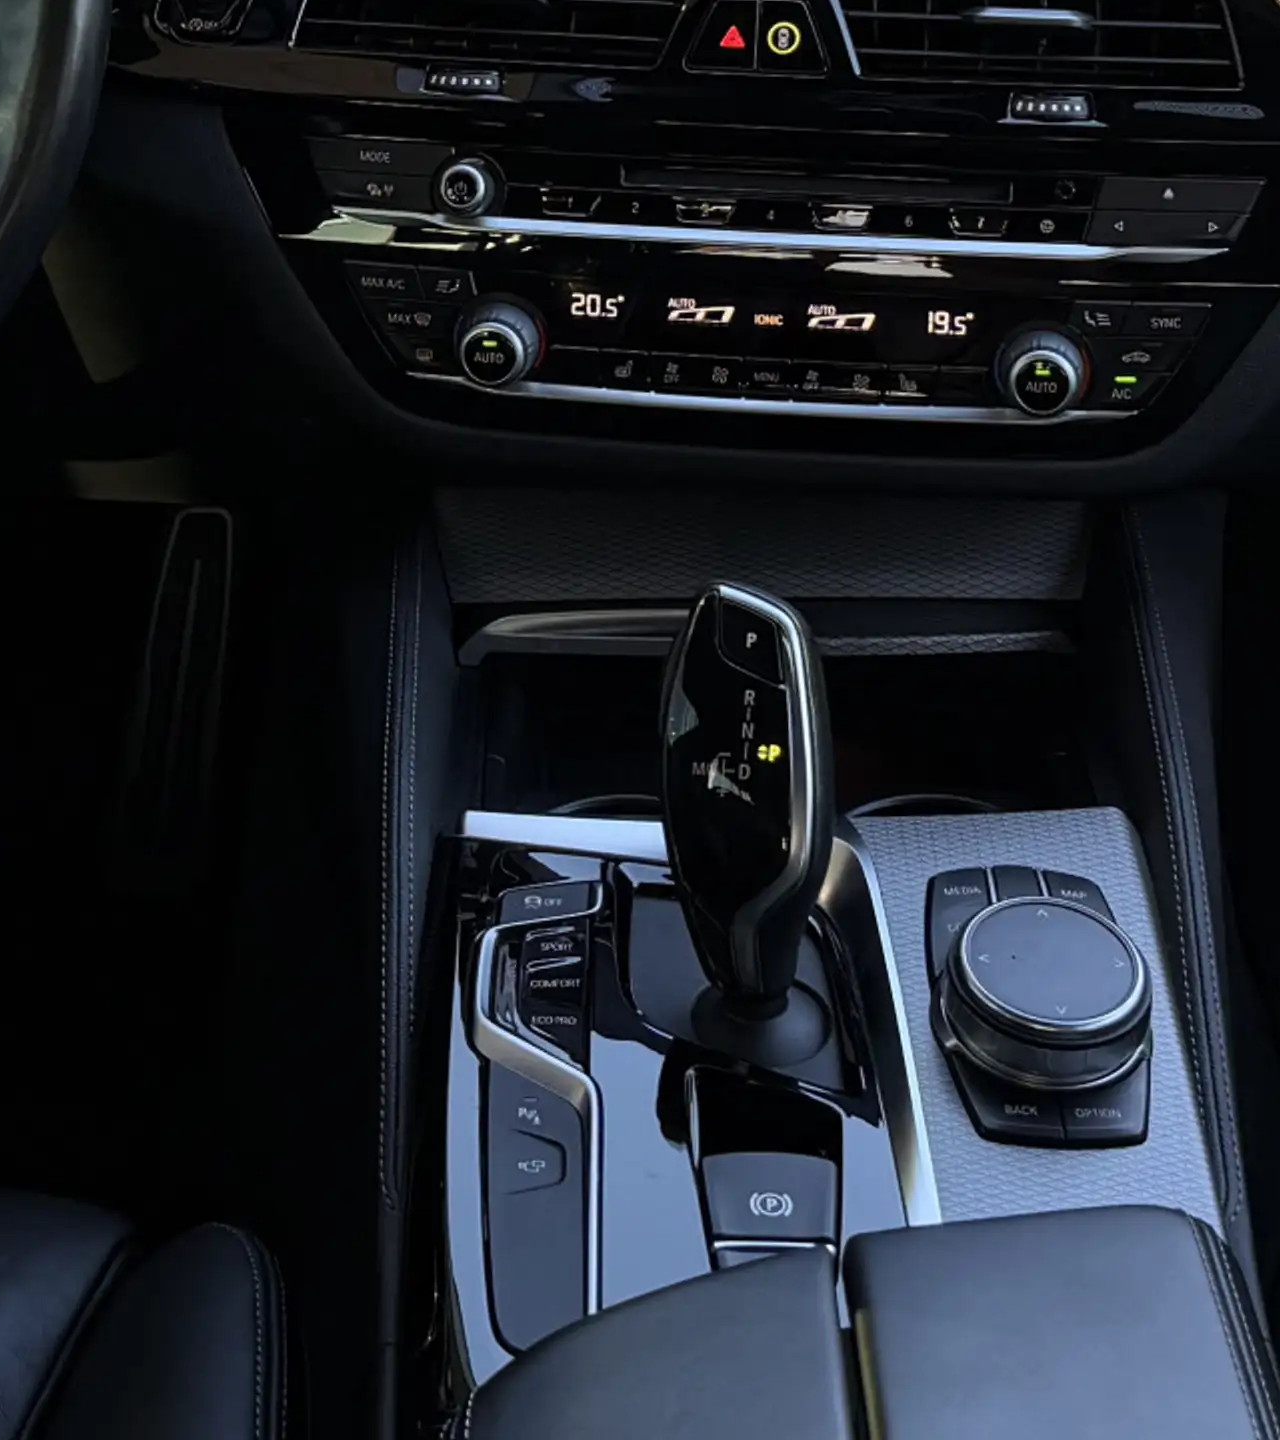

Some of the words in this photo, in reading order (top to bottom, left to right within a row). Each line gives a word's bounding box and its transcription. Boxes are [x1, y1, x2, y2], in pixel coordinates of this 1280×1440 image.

[359, 150, 391, 164] MODE
[631, 200, 640, 214] 2
[667, 296, 697, 309] AUTO
[806, 303, 837, 316] AUTO
[1149, 315, 1182, 330] SYNC
[473, 351, 505, 366] AUTO
[1024, 380, 1058, 395] AUTO
[1111, 387, 1132, 401] A/C
[745, 631, 759, 649] P
[743, 689, 756, 706] R
[741, 721, 755, 740] N
[737, 763, 752, 781] D
[943, 886, 983, 897] MEDIA
[1060, 888, 1088, 900] MAP
[540, 940, 574, 952] SPORT
[530, 977, 583, 990] COMFORT
[530, 1015, 554, 1027] ECO
[556, 1015, 579, 1027] PRO
[1003, 1103, 1039, 1118] BACK
[1074, 1107, 1123, 1120] OPTION
